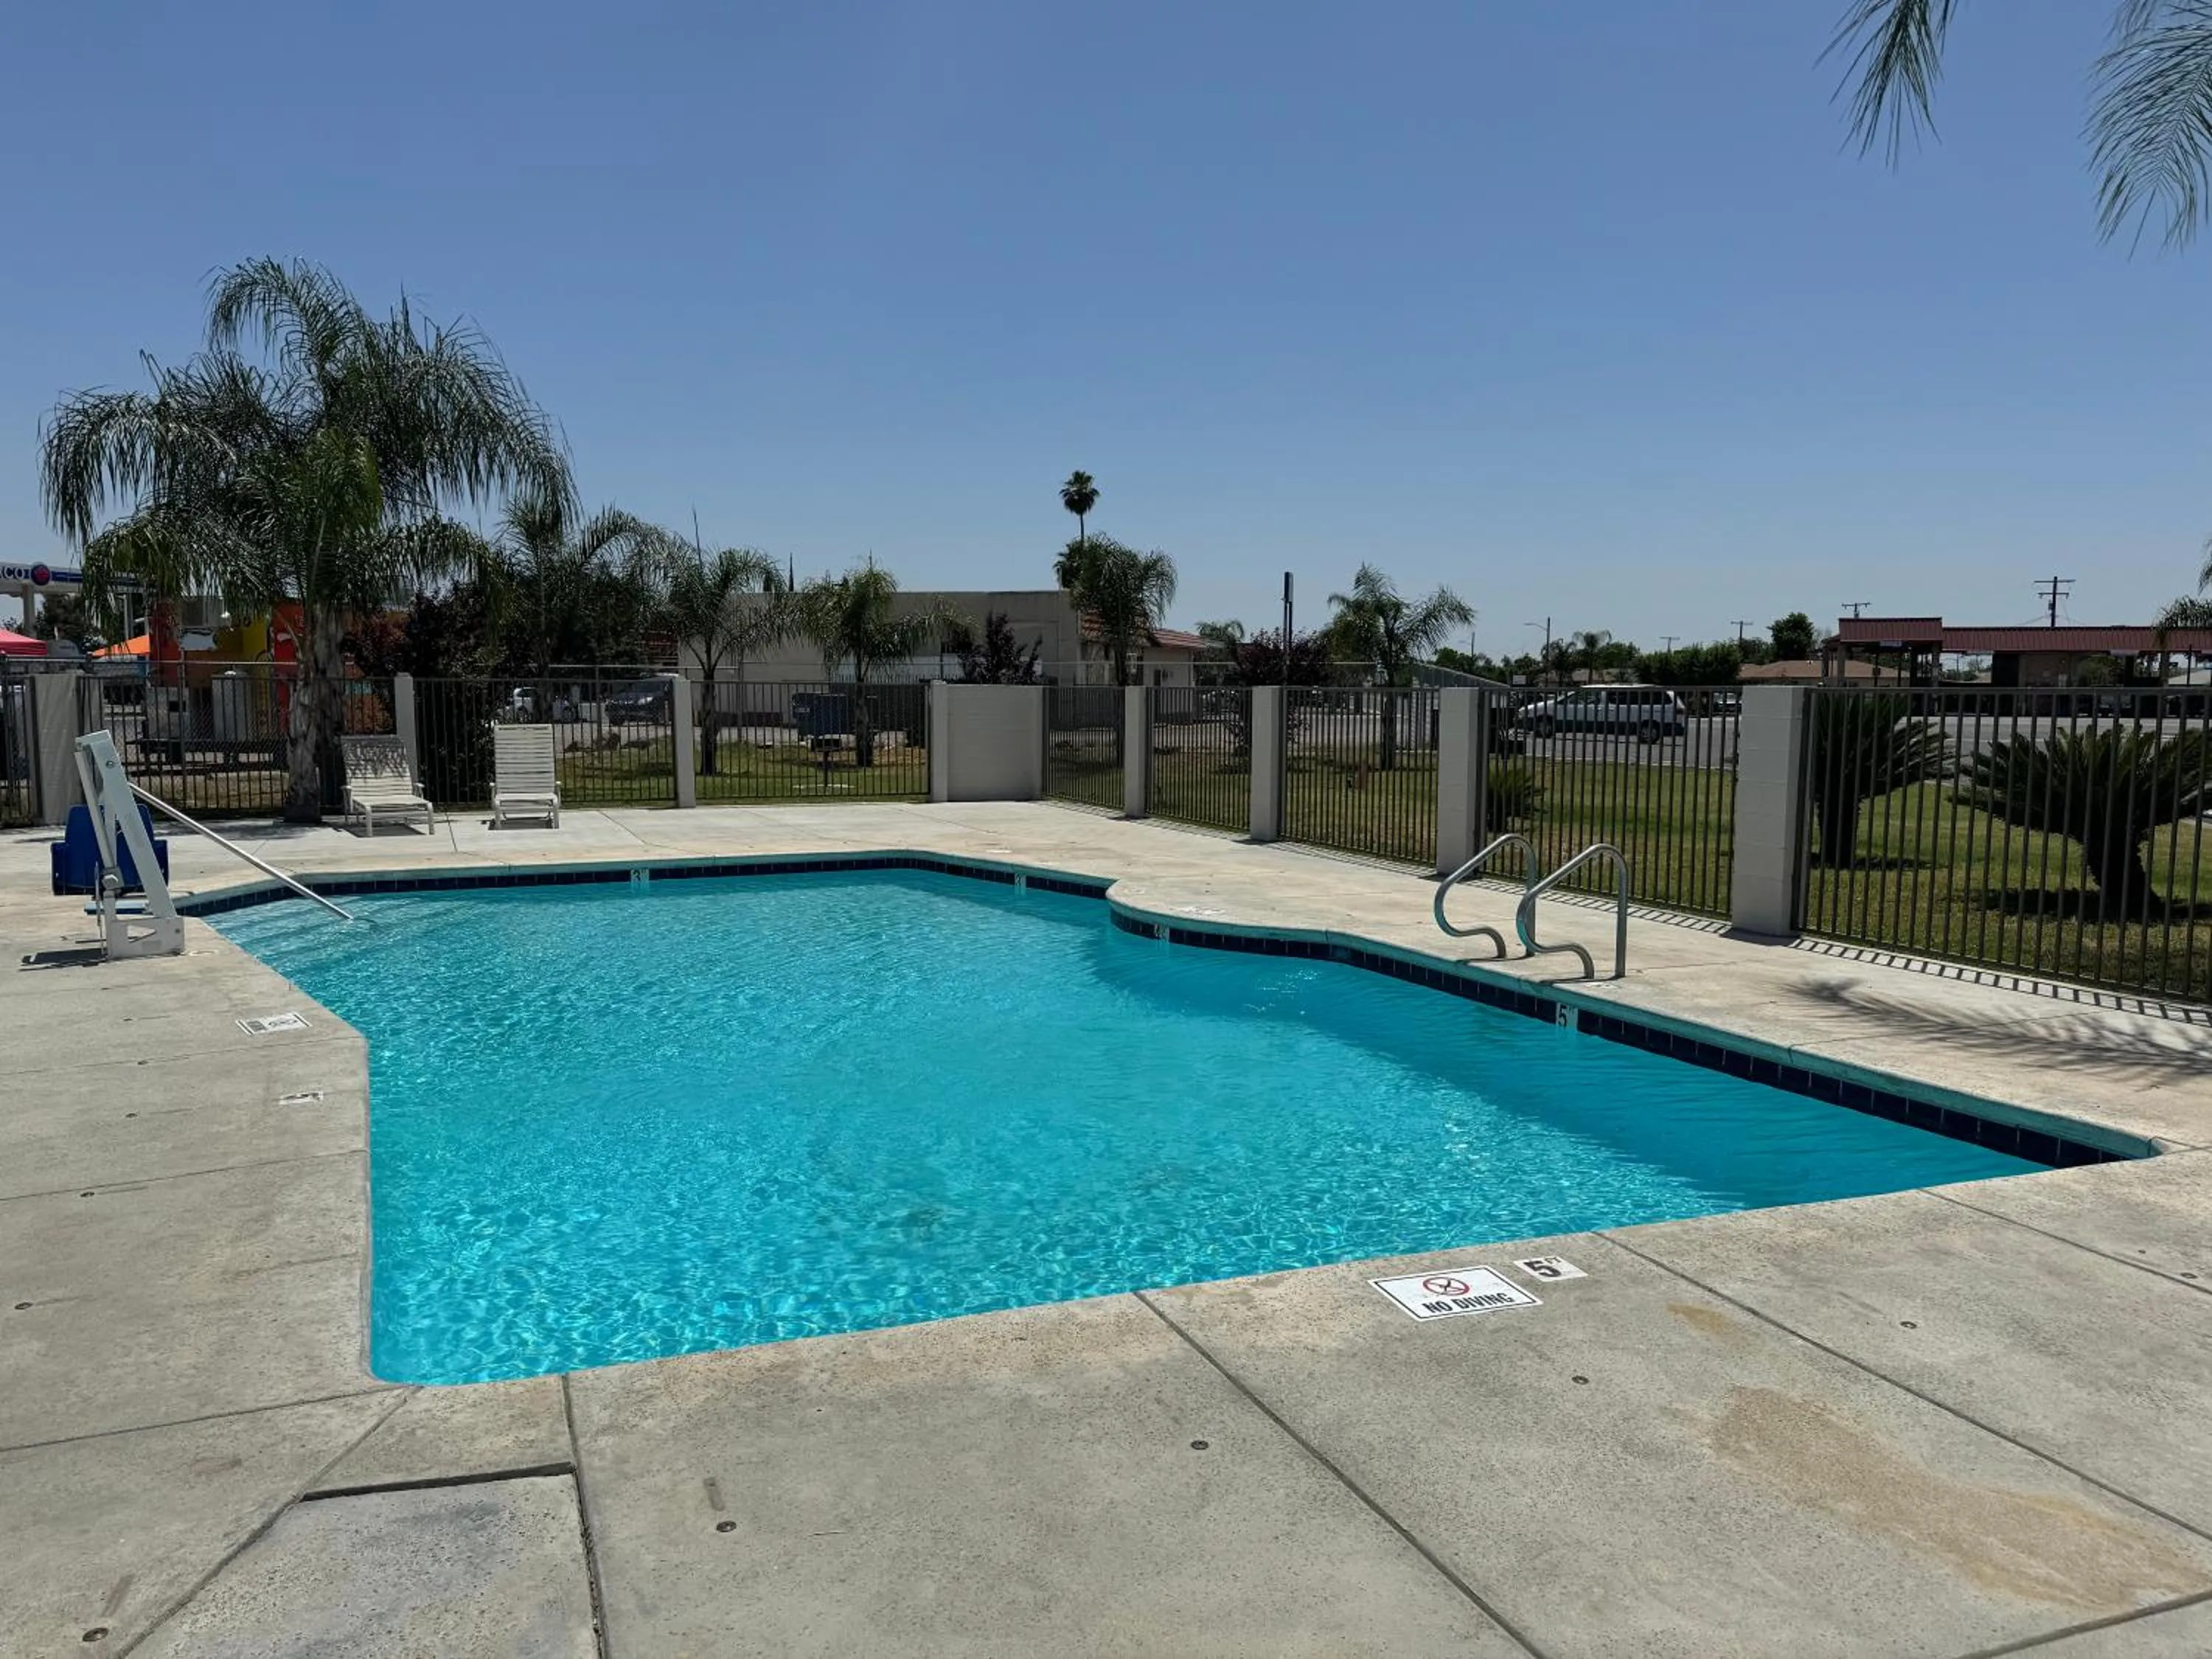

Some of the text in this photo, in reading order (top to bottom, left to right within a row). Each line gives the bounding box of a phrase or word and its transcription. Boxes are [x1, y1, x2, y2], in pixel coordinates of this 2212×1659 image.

[1558, 1004, 1567, 1027] 5
[1523, 1260, 1562, 1277] 5
[1422, 1292, 1514, 1314] NO DIVING
